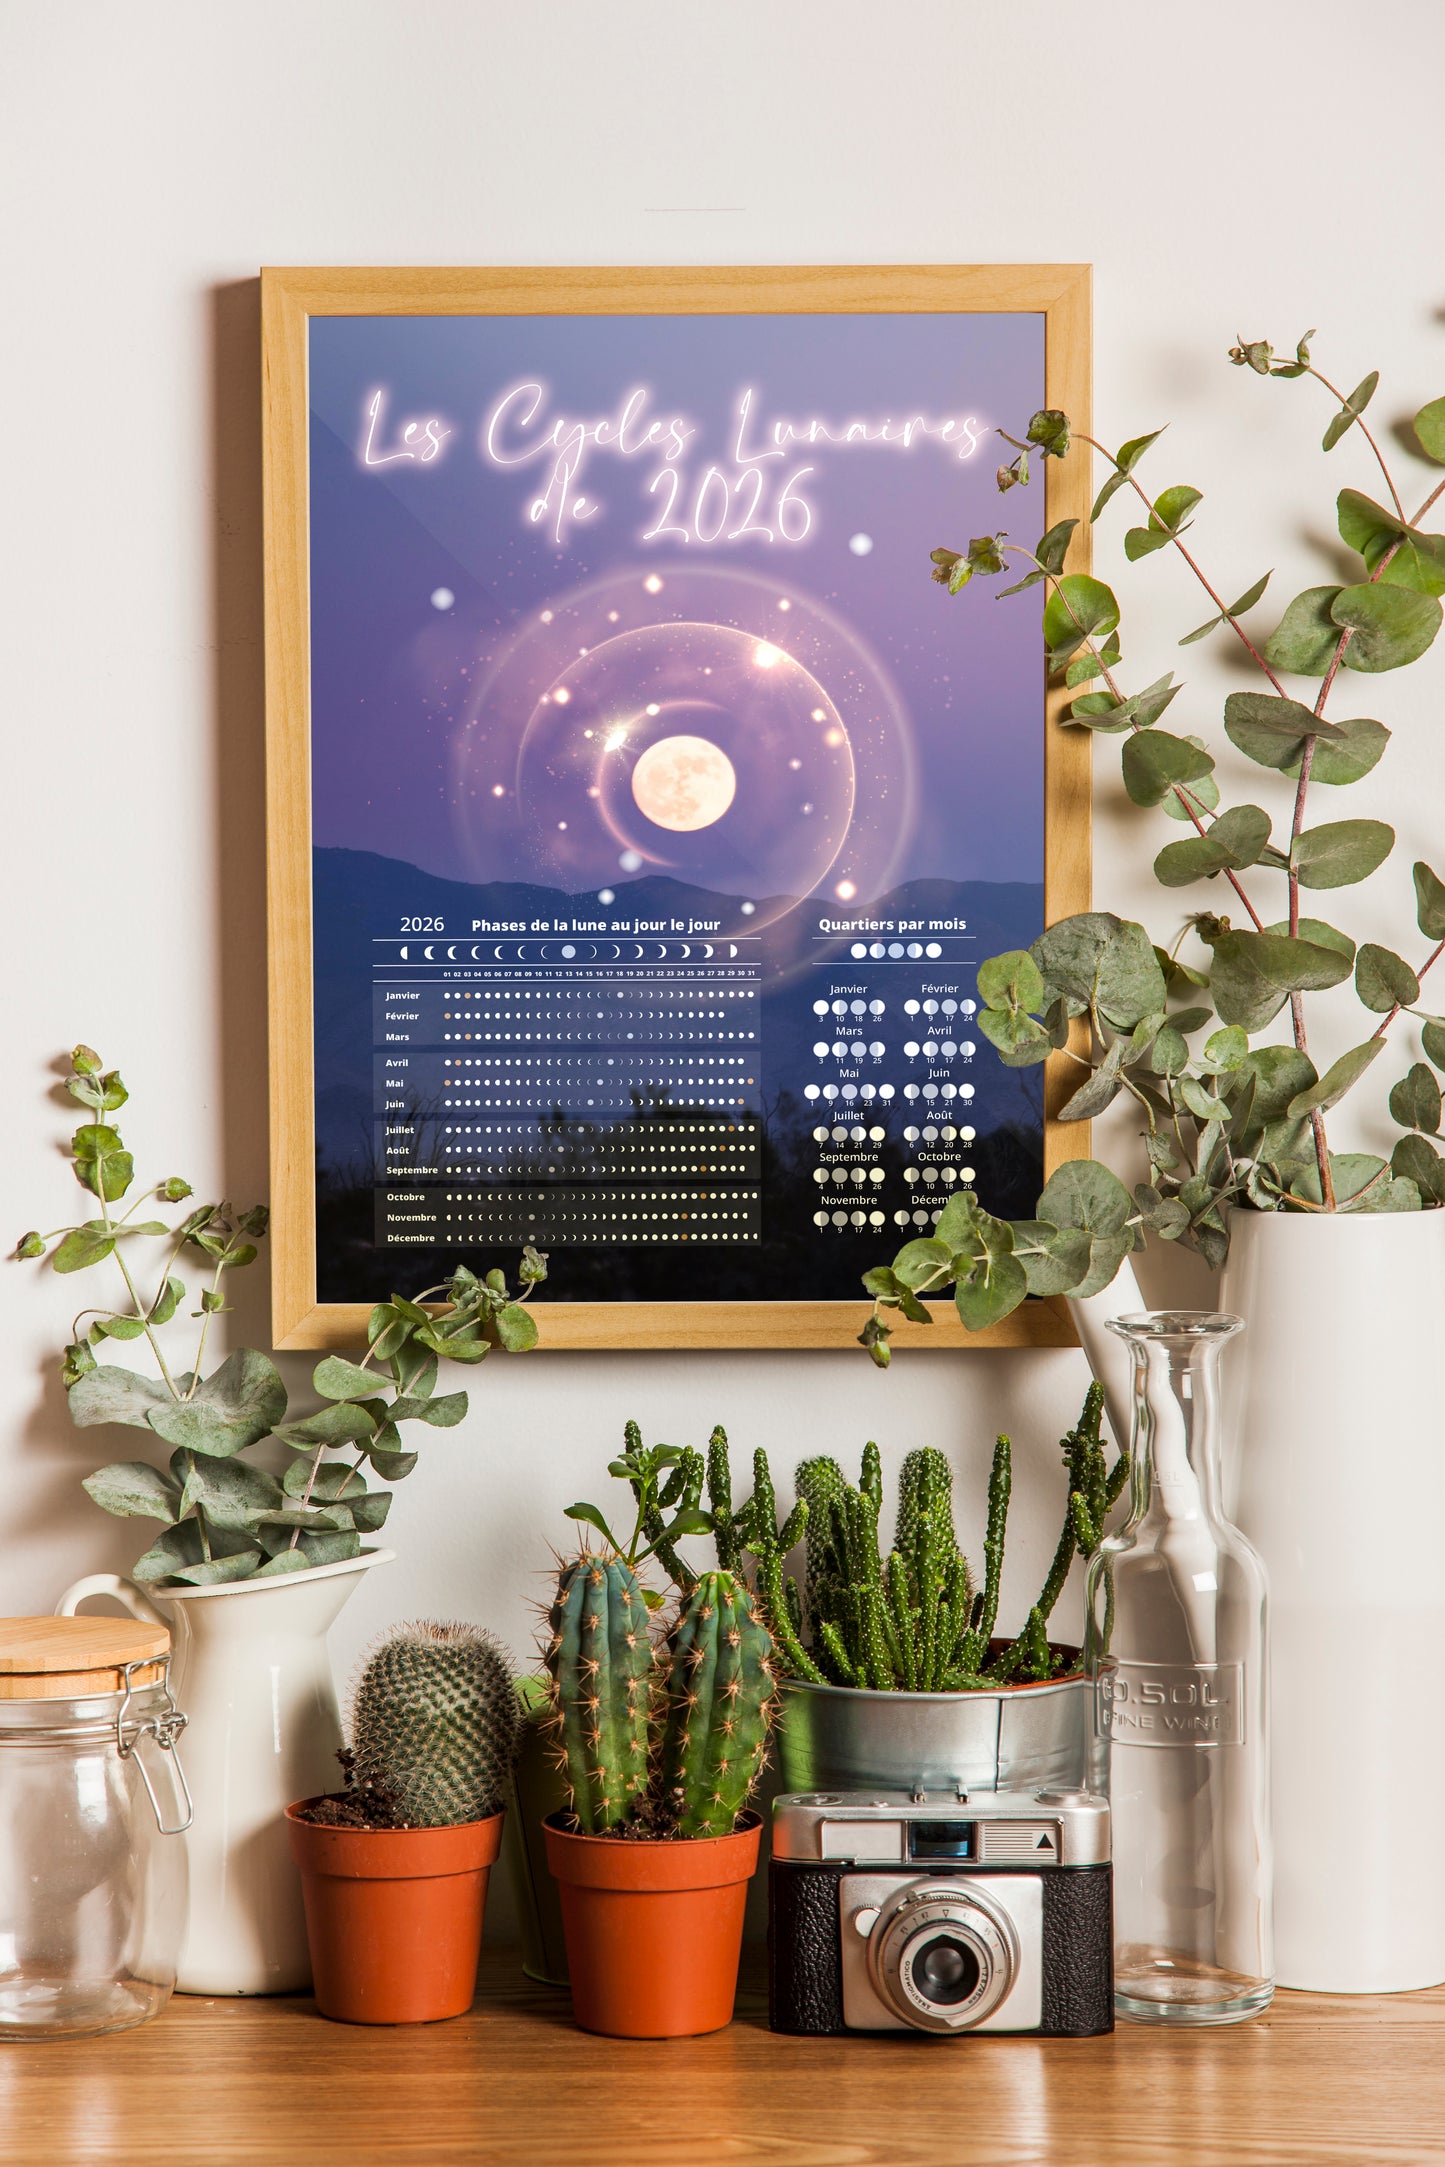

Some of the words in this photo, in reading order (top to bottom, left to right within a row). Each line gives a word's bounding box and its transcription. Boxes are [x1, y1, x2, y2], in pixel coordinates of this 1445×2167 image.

[365, 390, 451, 464] Les
[488, 384, 695, 485] Cycles
[736, 389, 989, 463] Lunaires
[531, 462, 598, 543] de
[643, 466, 814, 543] 2026
[400, 916, 445, 932] 2026
[472, 919, 527, 932] Phases
[530, 918, 550, 932] de
[553, 918, 568, 932] la
[572, 918, 607, 932] lune
[610, 921, 631, 931] au
[632, 918, 667, 935] jour
[670, 918, 685, 931] le
[687, 918, 721, 934] jour
[818, 917, 895, 933] Quartiers
[898, 920, 925, 934] par
[928, 917, 967, 930] mois
[829, 984, 868, 996] Janvier
[921, 983, 959, 994] Février
[385, 991, 421, 1002] Janvier
[385, 1011, 420, 1021] Février
[835, 1015, 845, 1023] 10
[854, 1015, 864, 1023] 18
[872, 1015, 882, 1023] 26
[945, 1014, 955, 1022] 17
[963, 1014, 973, 1022] 24
[835, 1026, 863, 1036] Mars
[927, 1025, 952, 1035] Avril
[385, 1033, 410, 1041] Mars
[385, 1058, 409, 1067] Avril
[854, 1057, 864, 1065] 19
[926, 1056, 936, 1064] 10
[945, 1056, 954, 1064] 17
[963, 1056, 973, 1064] 24
[839, 1068, 859, 1078] Mai
[927, 1068, 950, 1080] Juin
[385, 1079, 404, 1088] Mai
[384, 1099, 405, 1110] Juin
[845, 1099, 855, 1107] 16
[863, 1099, 873, 1107] 23
[882, 1099, 891, 1107] 31
[926, 1099, 935, 1107] 15
[832, 1110, 865, 1123] Juillet
[926, 1110, 953, 1120] Août
[384, 1125, 415, 1136] Juillet
[835, 1140, 845, 1149] 14
[854, 1140, 863, 1149] 21
[872, 1141, 882, 1149] 29
[926, 1141, 935, 1149] 12
[944, 1141, 954, 1149] 20
[386, 1146, 410, 1155] Août
[819, 1152, 879, 1164] Septembre
[917, 1151, 962, 1162] Octobre
[386, 1165, 439, 1177] Septembre
[926, 1182, 935, 1190] 10
[944, 1182, 954, 1190] 18
[963, 1182, 973, 1190] 26
[386, 1192, 425, 1201] Octobre
[821, 1195, 878, 1205] Novembre
[911, 1194, 951, 1204] Décem
[387, 1213, 437, 1222] Novembre
[872, 1226, 882, 1234] 24
[387, 1233, 436, 1242] Décembre
